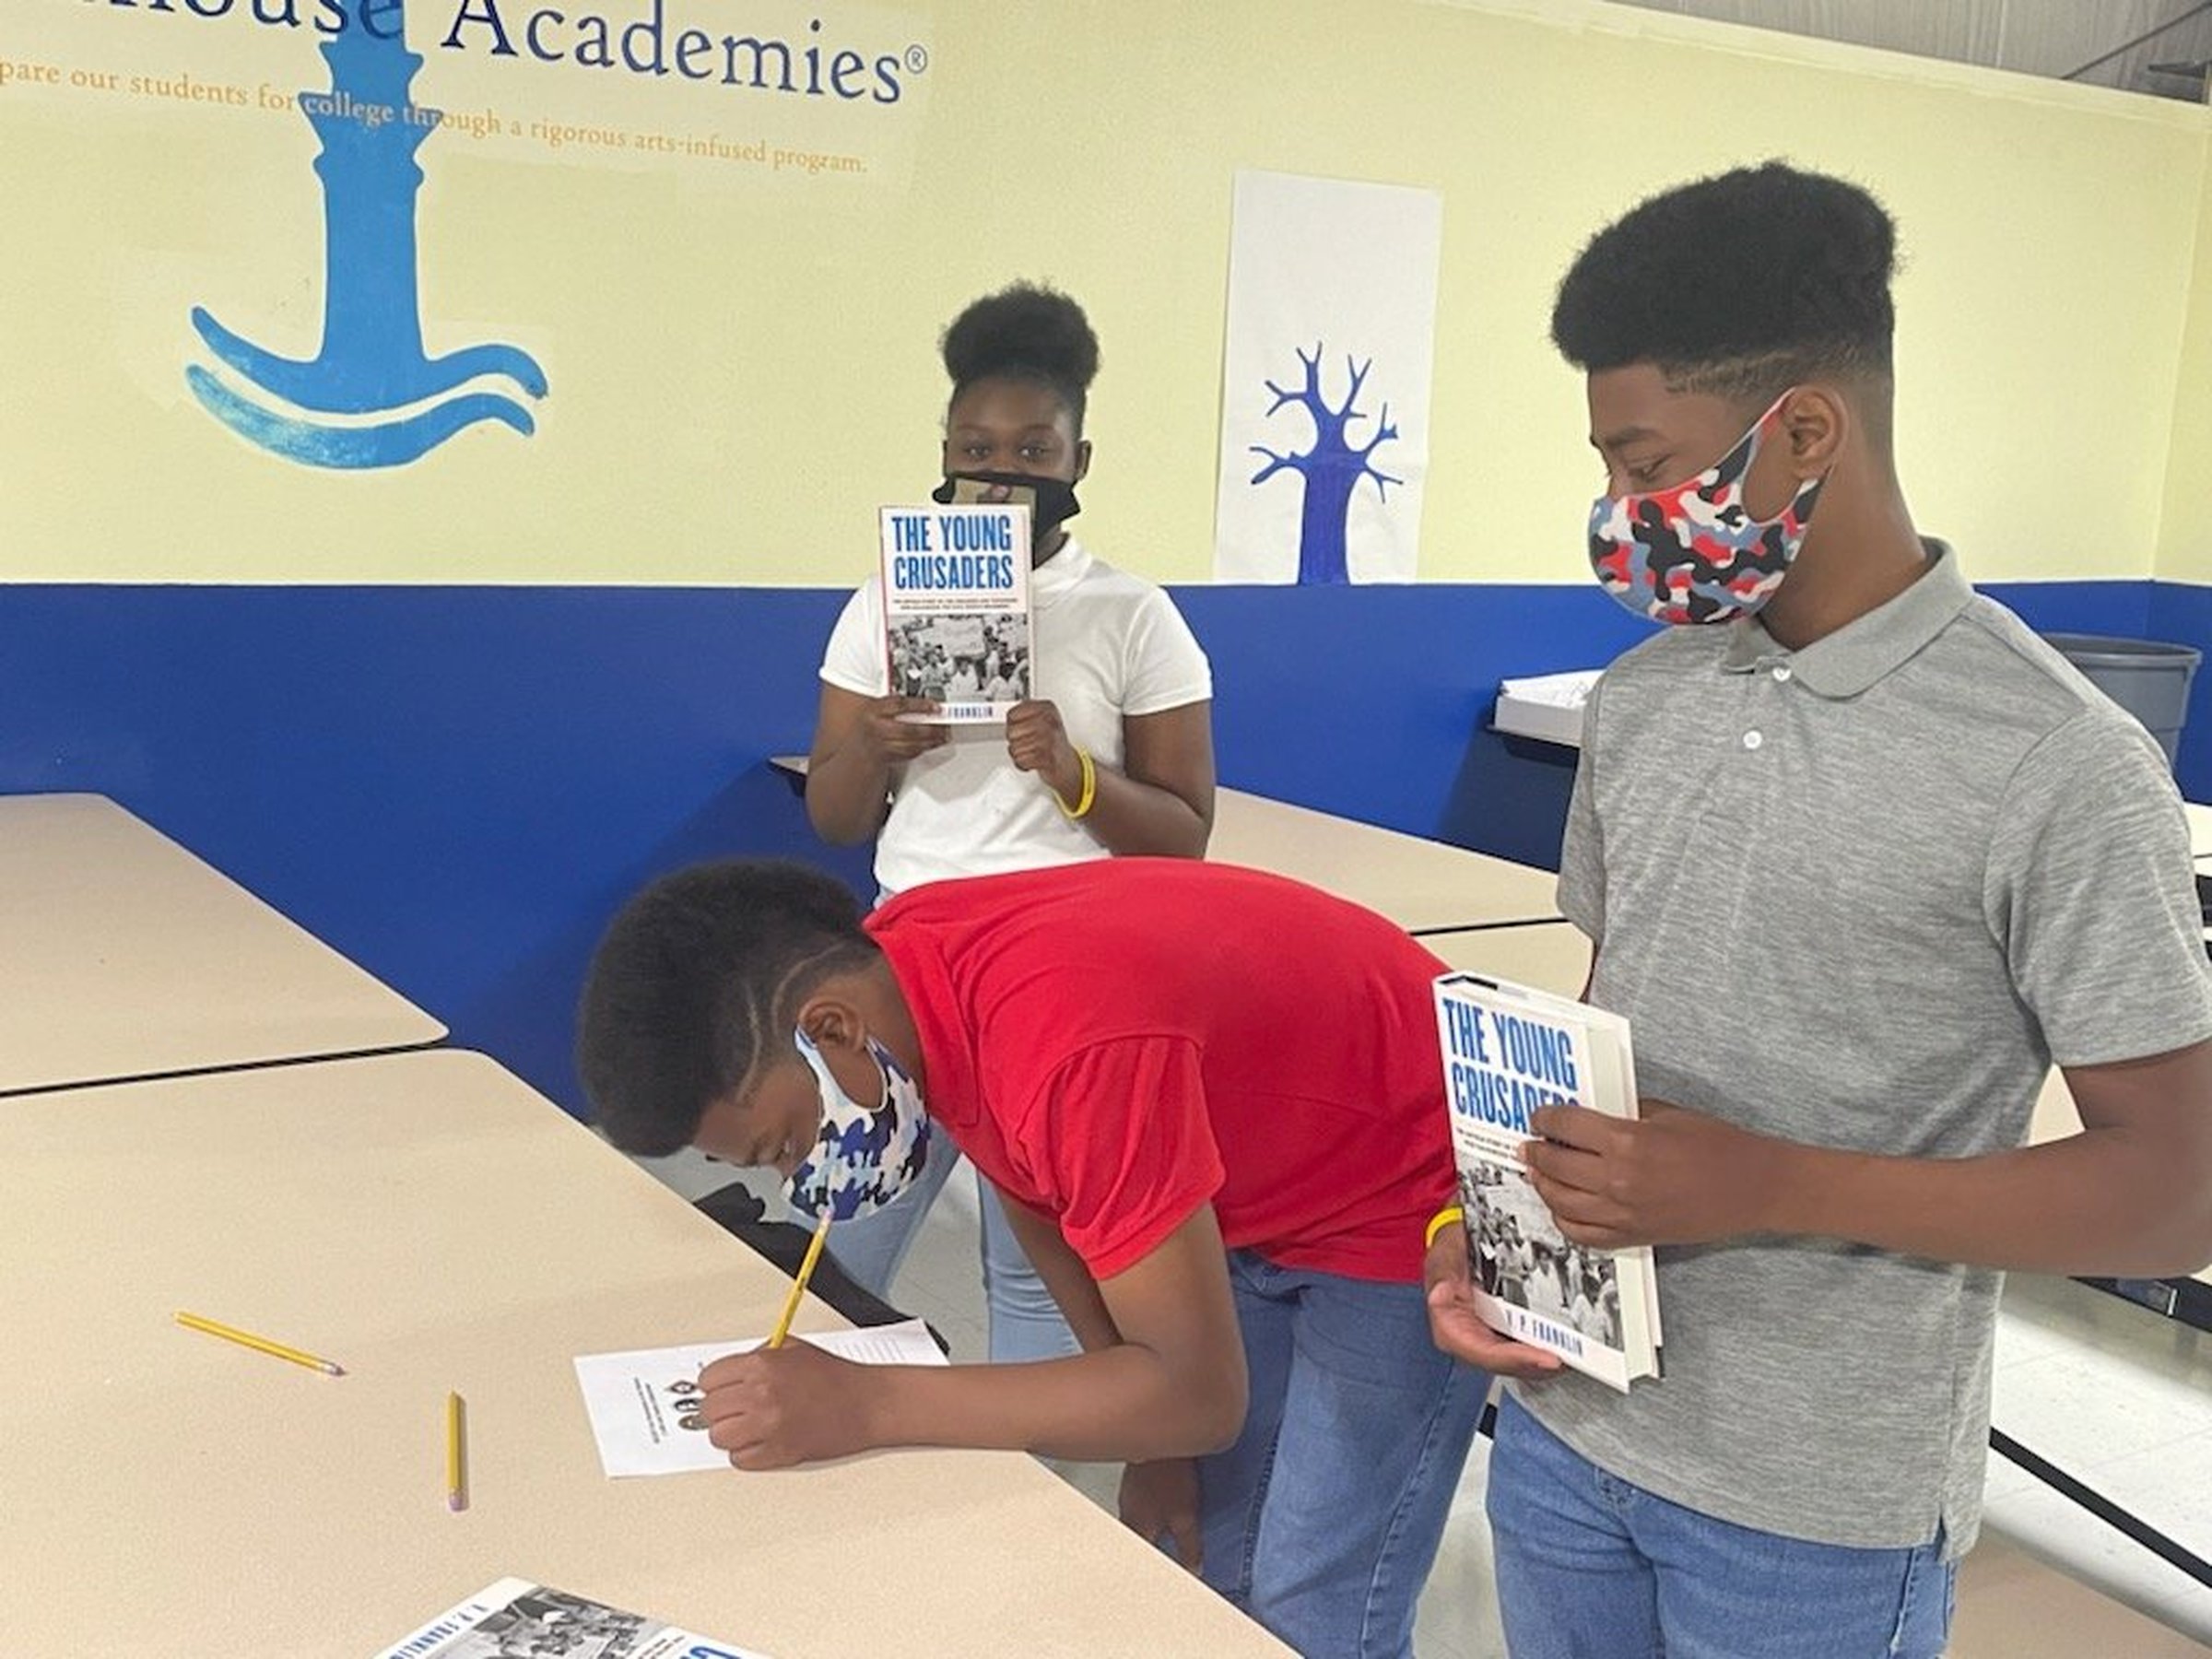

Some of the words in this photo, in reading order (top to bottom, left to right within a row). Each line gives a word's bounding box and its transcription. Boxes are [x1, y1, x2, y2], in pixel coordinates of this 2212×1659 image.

[70, 69, 119, 90] our
[129, 73, 247, 106] students
[258, 84, 295, 111] for
[304, 91, 394, 126] college
[403, 101, 500, 138] through
[510, 121, 522, 136] a
[531, 117, 627, 148] rigorous
[634, 134, 767, 163] arts-infused
[772, 148, 868, 175] program.
[891, 516, 932, 551] THE
[938, 514, 1012, 551] YOUNG
[894, 555, 1013, 589] CRUSADERS
[1442, 997, 1489, 1064] THE
[1491, 1012, 1579, 1091] YOUNG
[1451, 1061, 1581, 1135] CRUSAD
